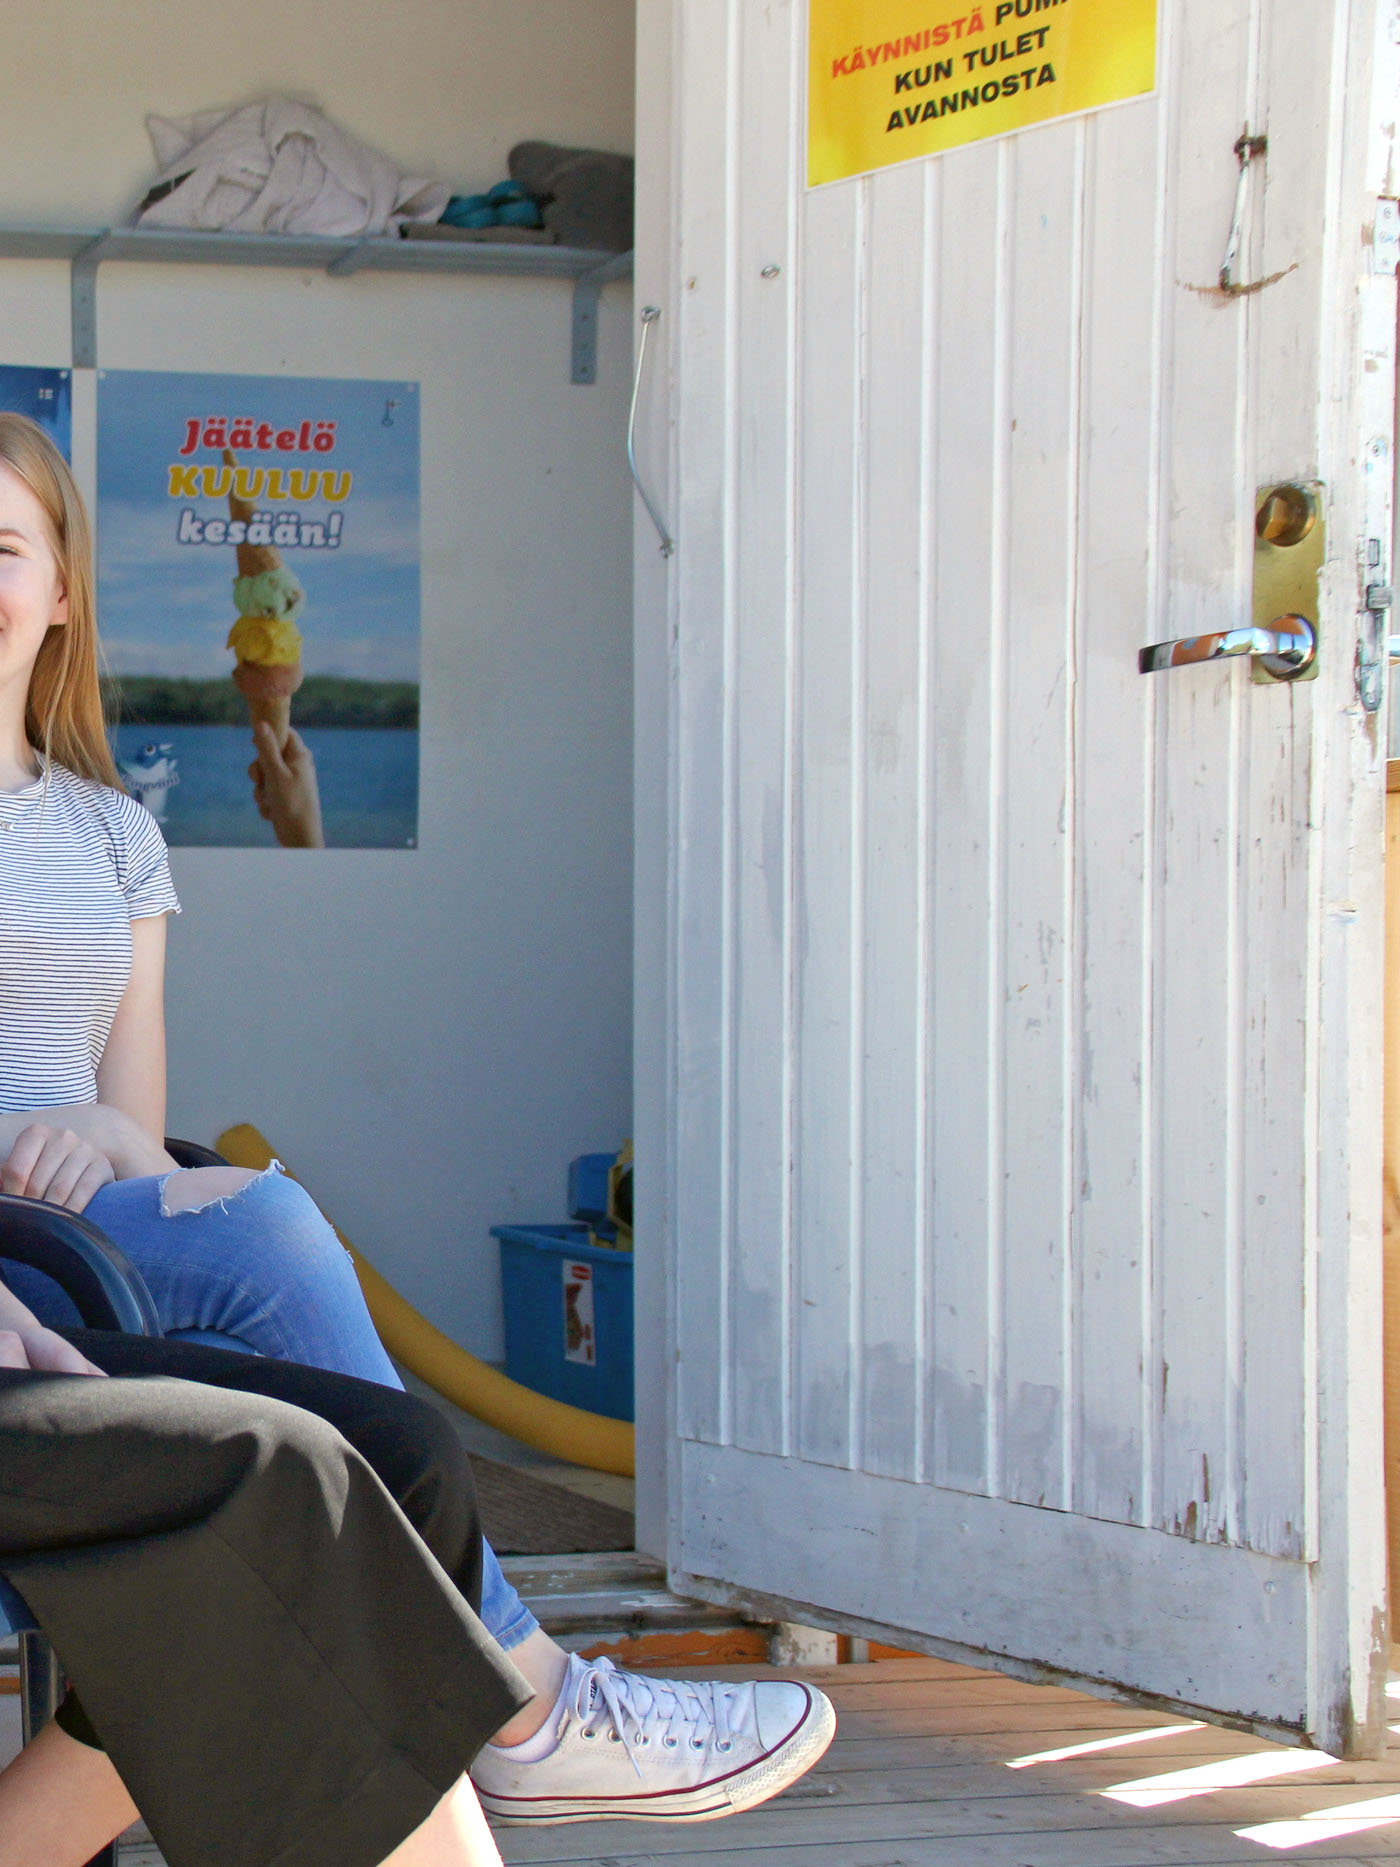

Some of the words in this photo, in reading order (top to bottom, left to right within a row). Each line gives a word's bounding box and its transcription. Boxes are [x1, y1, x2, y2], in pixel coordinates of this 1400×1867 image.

[831, 7, 985, 78] KÄYNNISTÄ
[894, 58, 953, 94] KUN
[963, 26, 1050, 72] TULET
[885, 63, 1056, 133] AVANNOSTA
[180, 416, 337, 456] Jäätelö
[168, 465, 352, 502] KUULUU
[178, 508, 344, 549] kesään!
